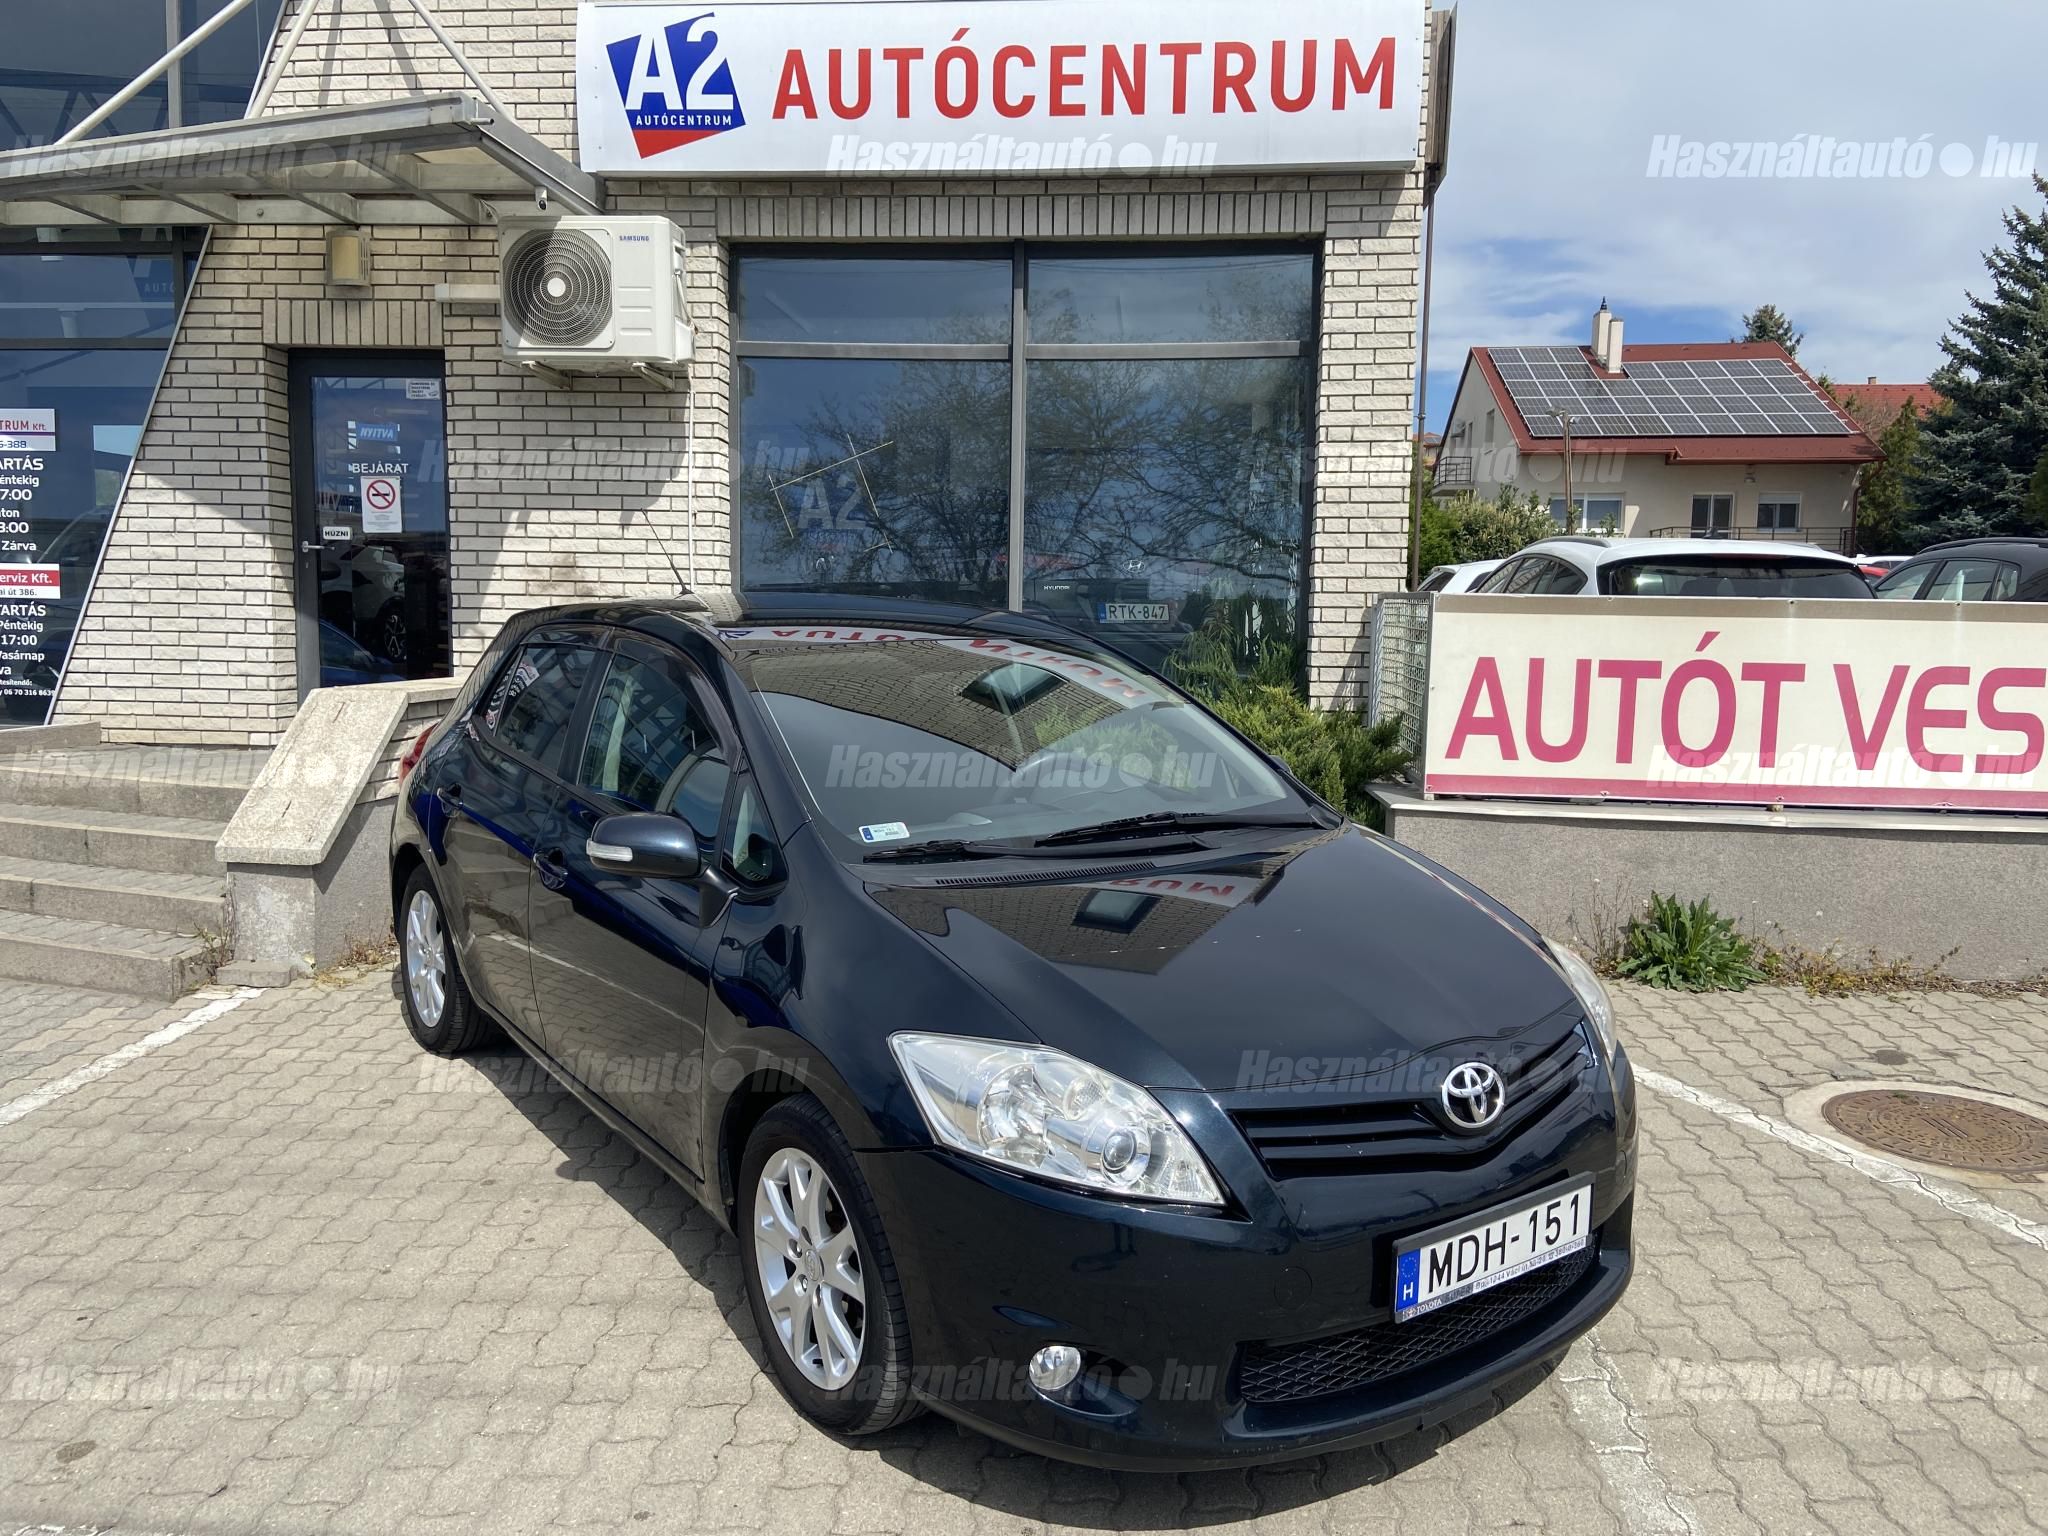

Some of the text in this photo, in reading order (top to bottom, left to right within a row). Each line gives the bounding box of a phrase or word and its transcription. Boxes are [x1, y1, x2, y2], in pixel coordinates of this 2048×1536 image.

[625, 16, 734, 110] A2
[772, 27, 1396, 120] AUTÓCENTRUM
[635, 113, 732, 126] AUTÓCENTRUM
[352, 460, 409, 473] BEJÁRAT
[1, 540, 37, 551] Zárva
[31, 573, 53, 583] Kft.
[20, 588, 37, 597] 386.
[1108, 605, 1165, 619] RTK-847
[1, 634, 38, 646] 17:00
[1444, 631, 2047, 774] AUTÓT VES
[1428, 1193, 1580, 1293] MDH-151
[1403, 1281, 1414, 1301] H
[1416, 1298, 1442, 1315] TOYOTA
